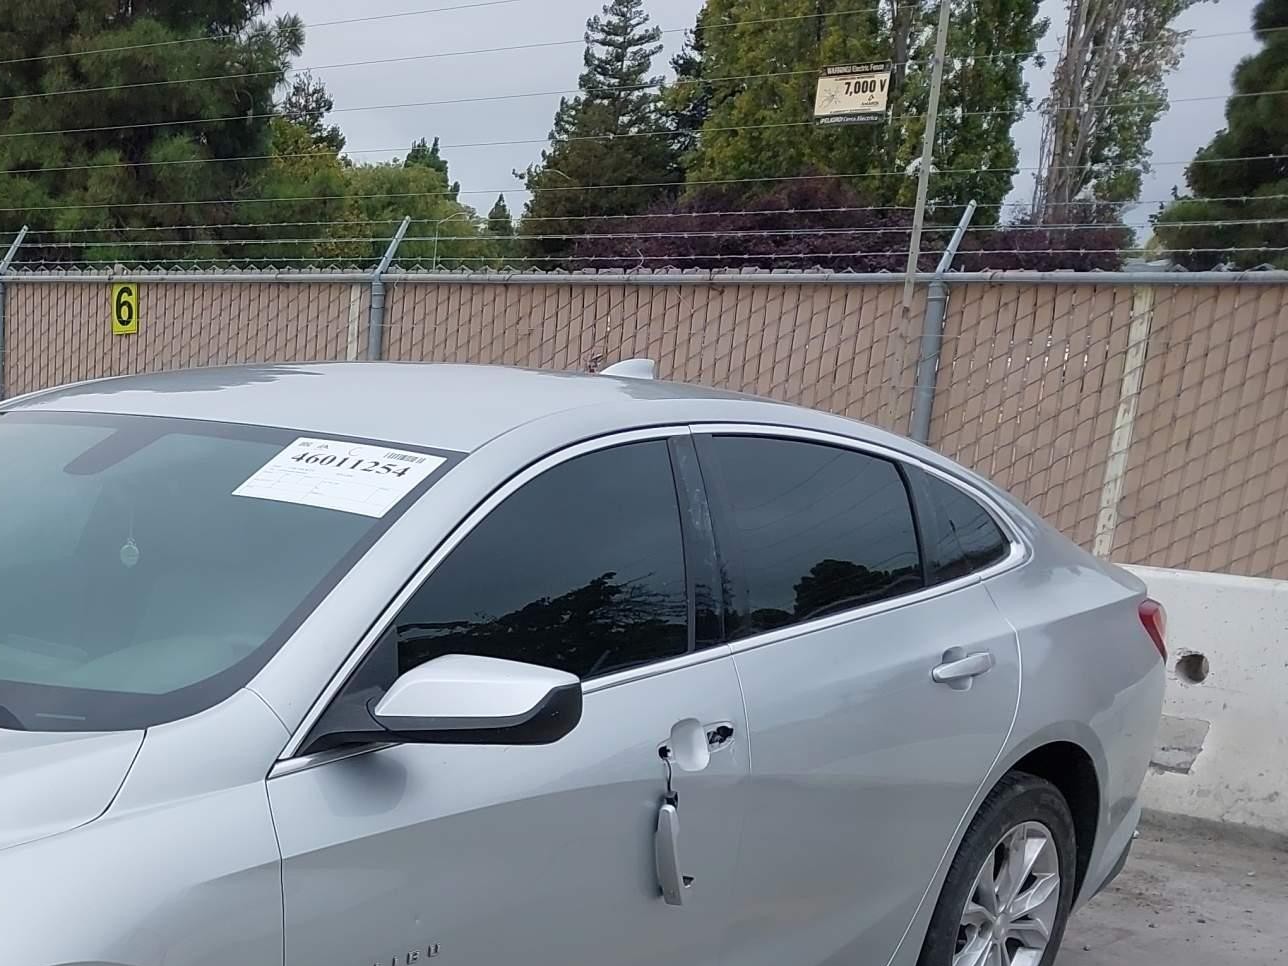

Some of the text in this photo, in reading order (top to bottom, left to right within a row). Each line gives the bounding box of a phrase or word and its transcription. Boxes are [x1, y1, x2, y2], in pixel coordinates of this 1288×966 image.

[845, 79, 887, 96] 7,000 V
[116, 286, 133, 326] 6
[291, 452, 411, 478] 46011254
